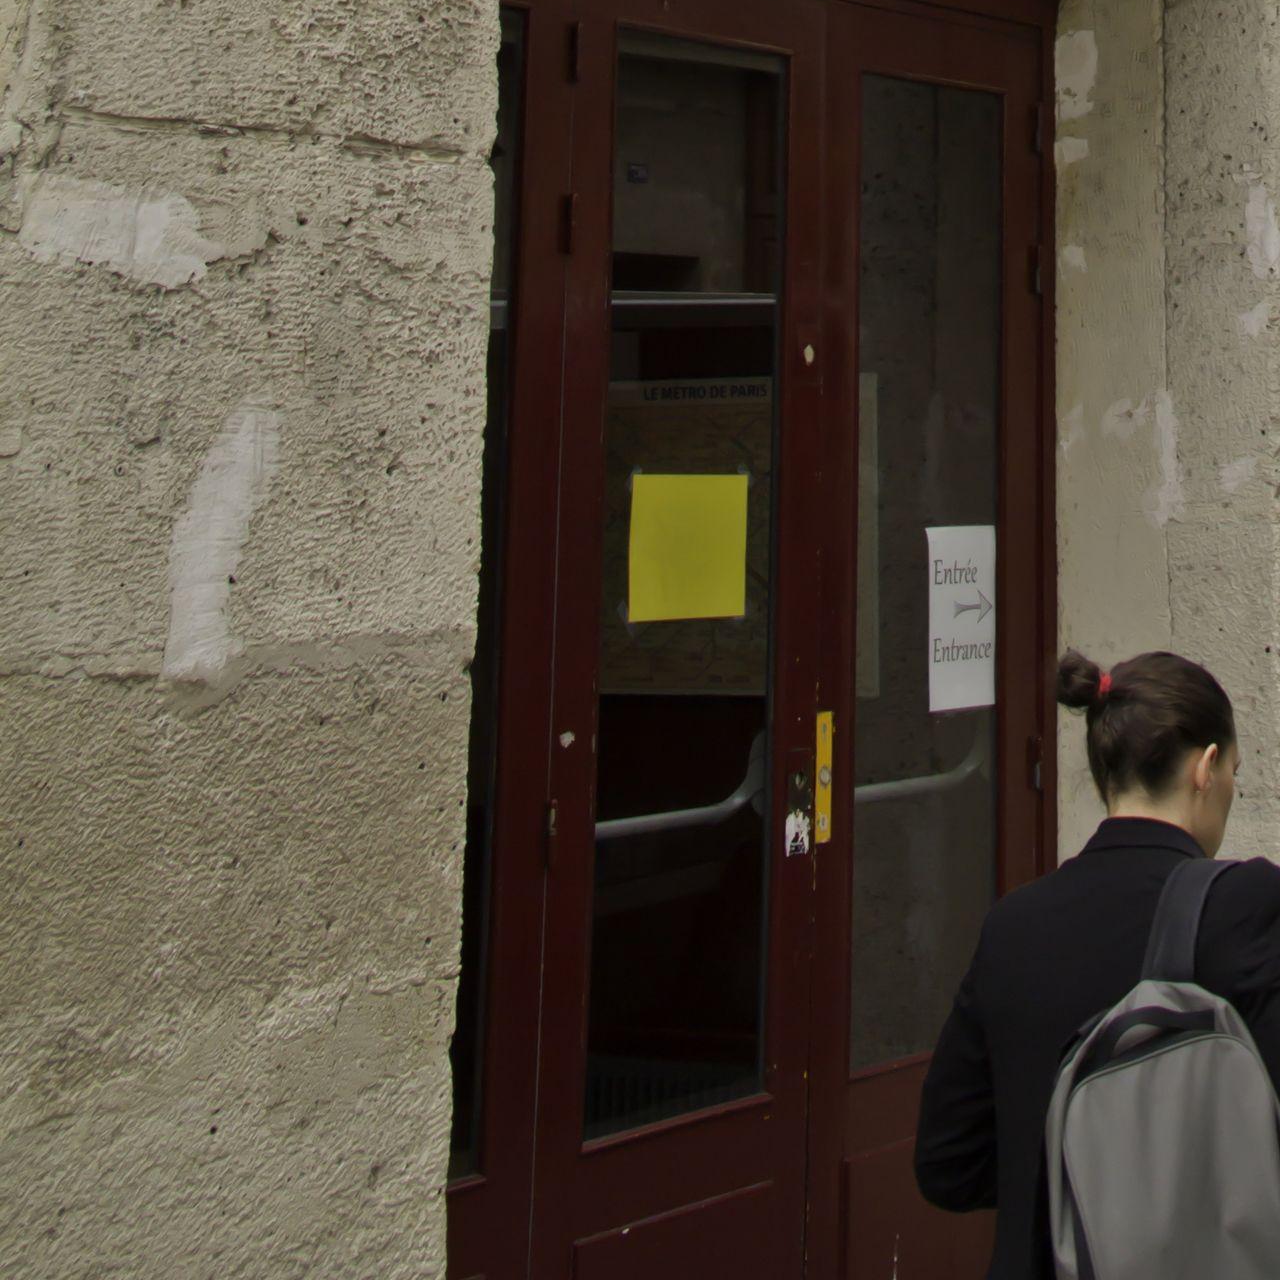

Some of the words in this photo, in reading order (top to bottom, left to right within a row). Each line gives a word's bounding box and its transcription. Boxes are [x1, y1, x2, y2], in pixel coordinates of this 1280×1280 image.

[643, 386, 658, 401] LE
[710, 385, 728, 399] DE
[730, 383, 768, 398] PARIS
[933, 558, 978, 586] Entrée
[933, 637, 992, 664] Entrance
